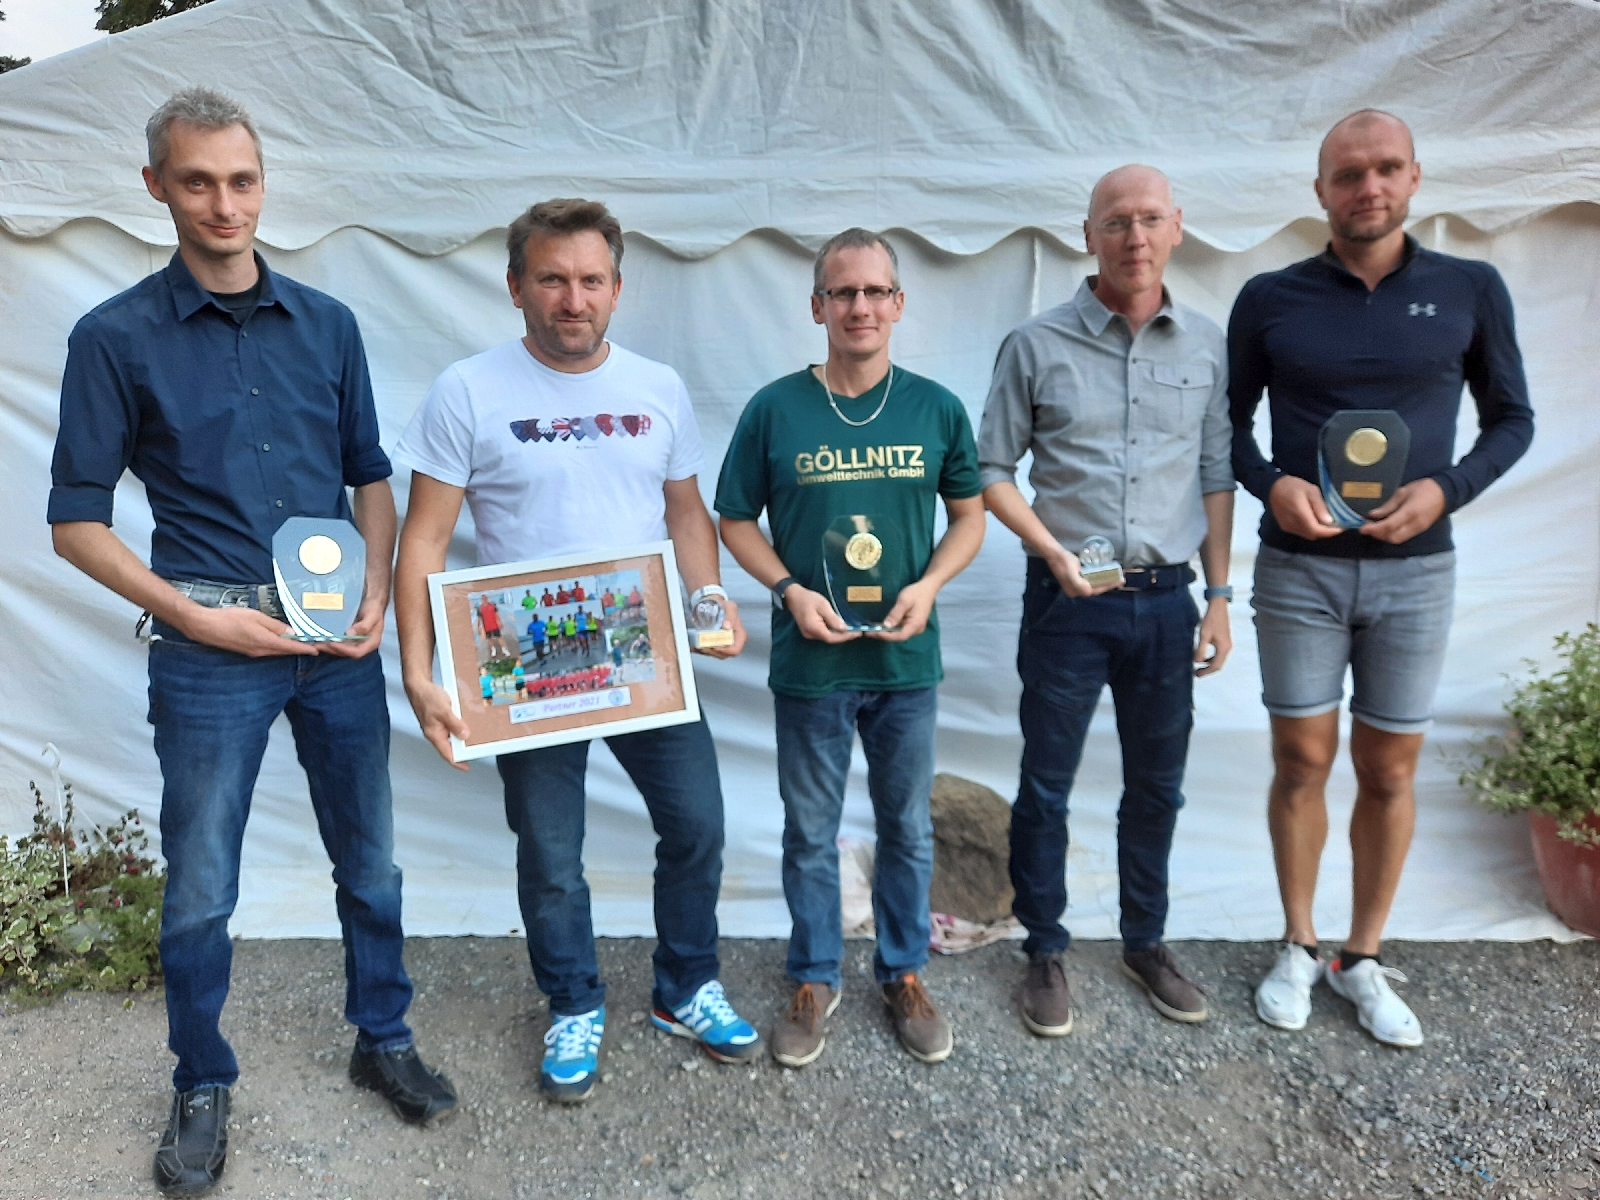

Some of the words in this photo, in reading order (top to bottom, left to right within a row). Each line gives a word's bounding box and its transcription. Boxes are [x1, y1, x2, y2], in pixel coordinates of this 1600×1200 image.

[794, 444, 925, 473] GÖLLNITZ
[797, 467, 885, 485] Umwelttechnik
[888, 466, 925, 478] GmbH
[543, 701, 576, 713] Partner
[579, 696, 600, 708] 2021
